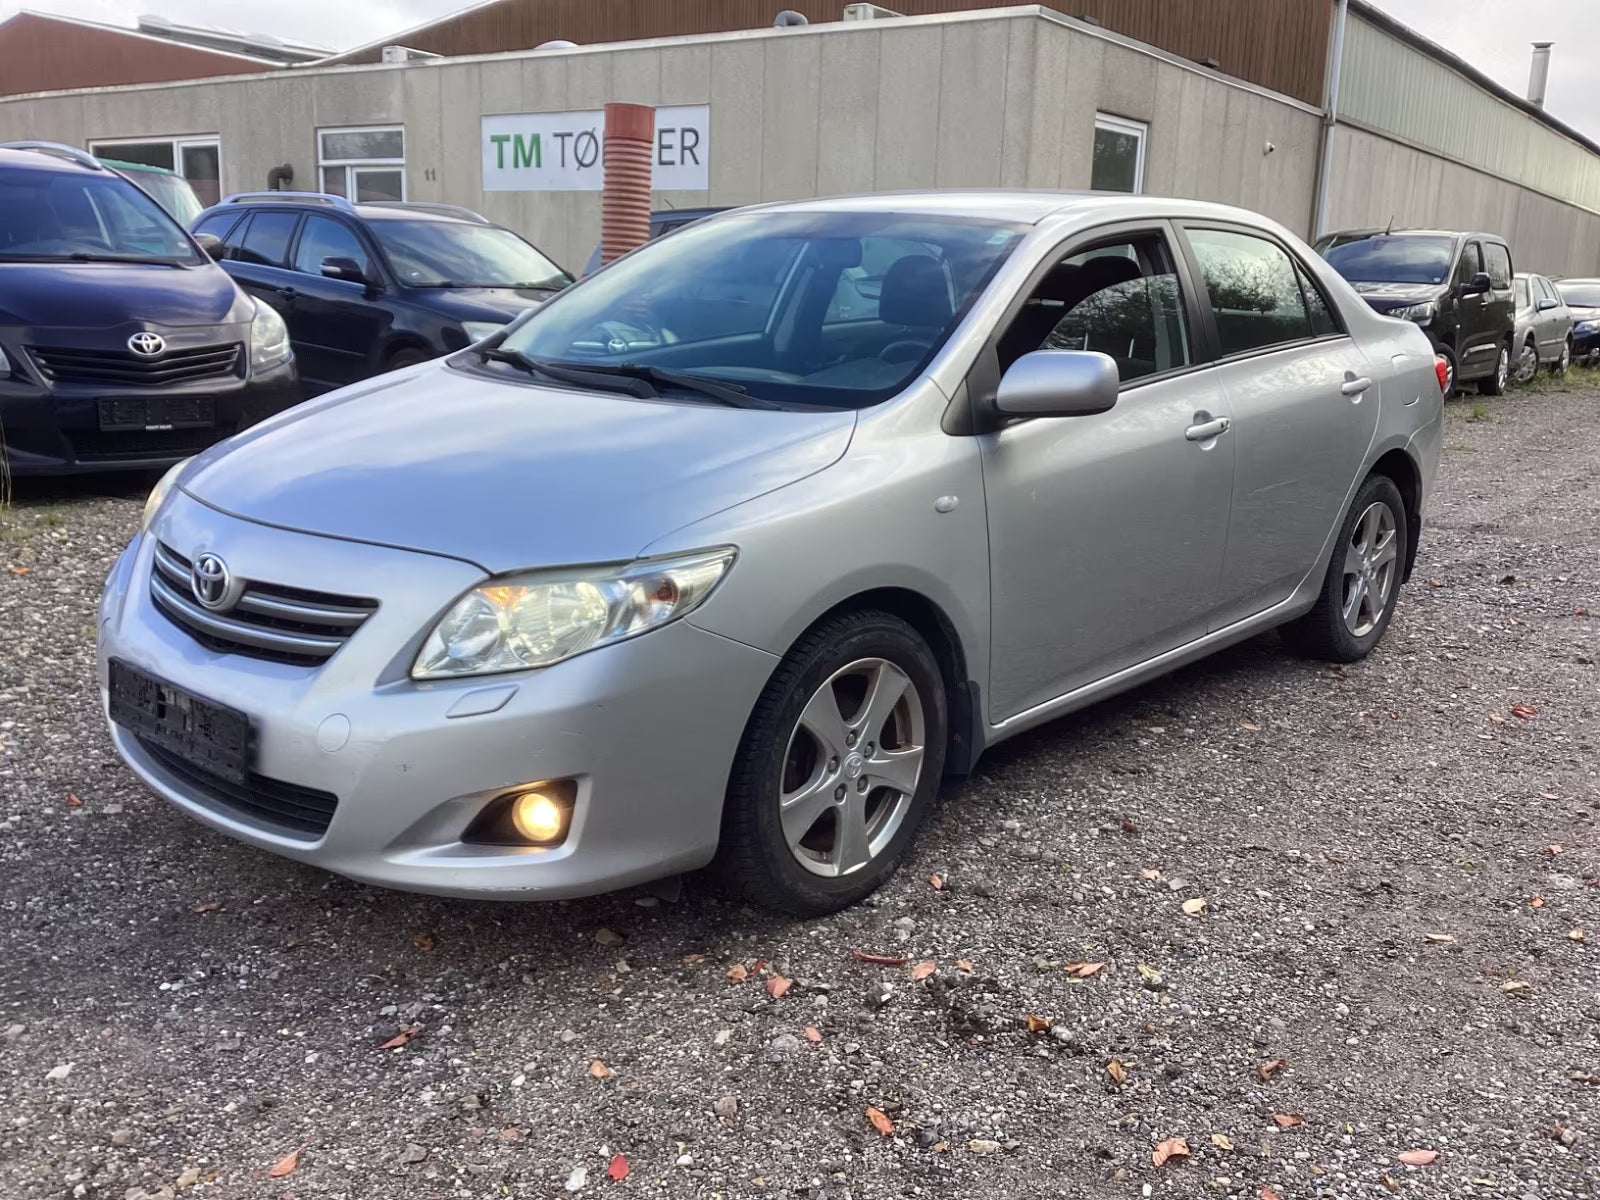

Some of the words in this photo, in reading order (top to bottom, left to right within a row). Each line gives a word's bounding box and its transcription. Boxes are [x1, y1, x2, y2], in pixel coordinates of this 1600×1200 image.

[490, 133, 542, 169] TM
[552, 127, 700, 171] TØER
[424, 168, 436, 181] 11
